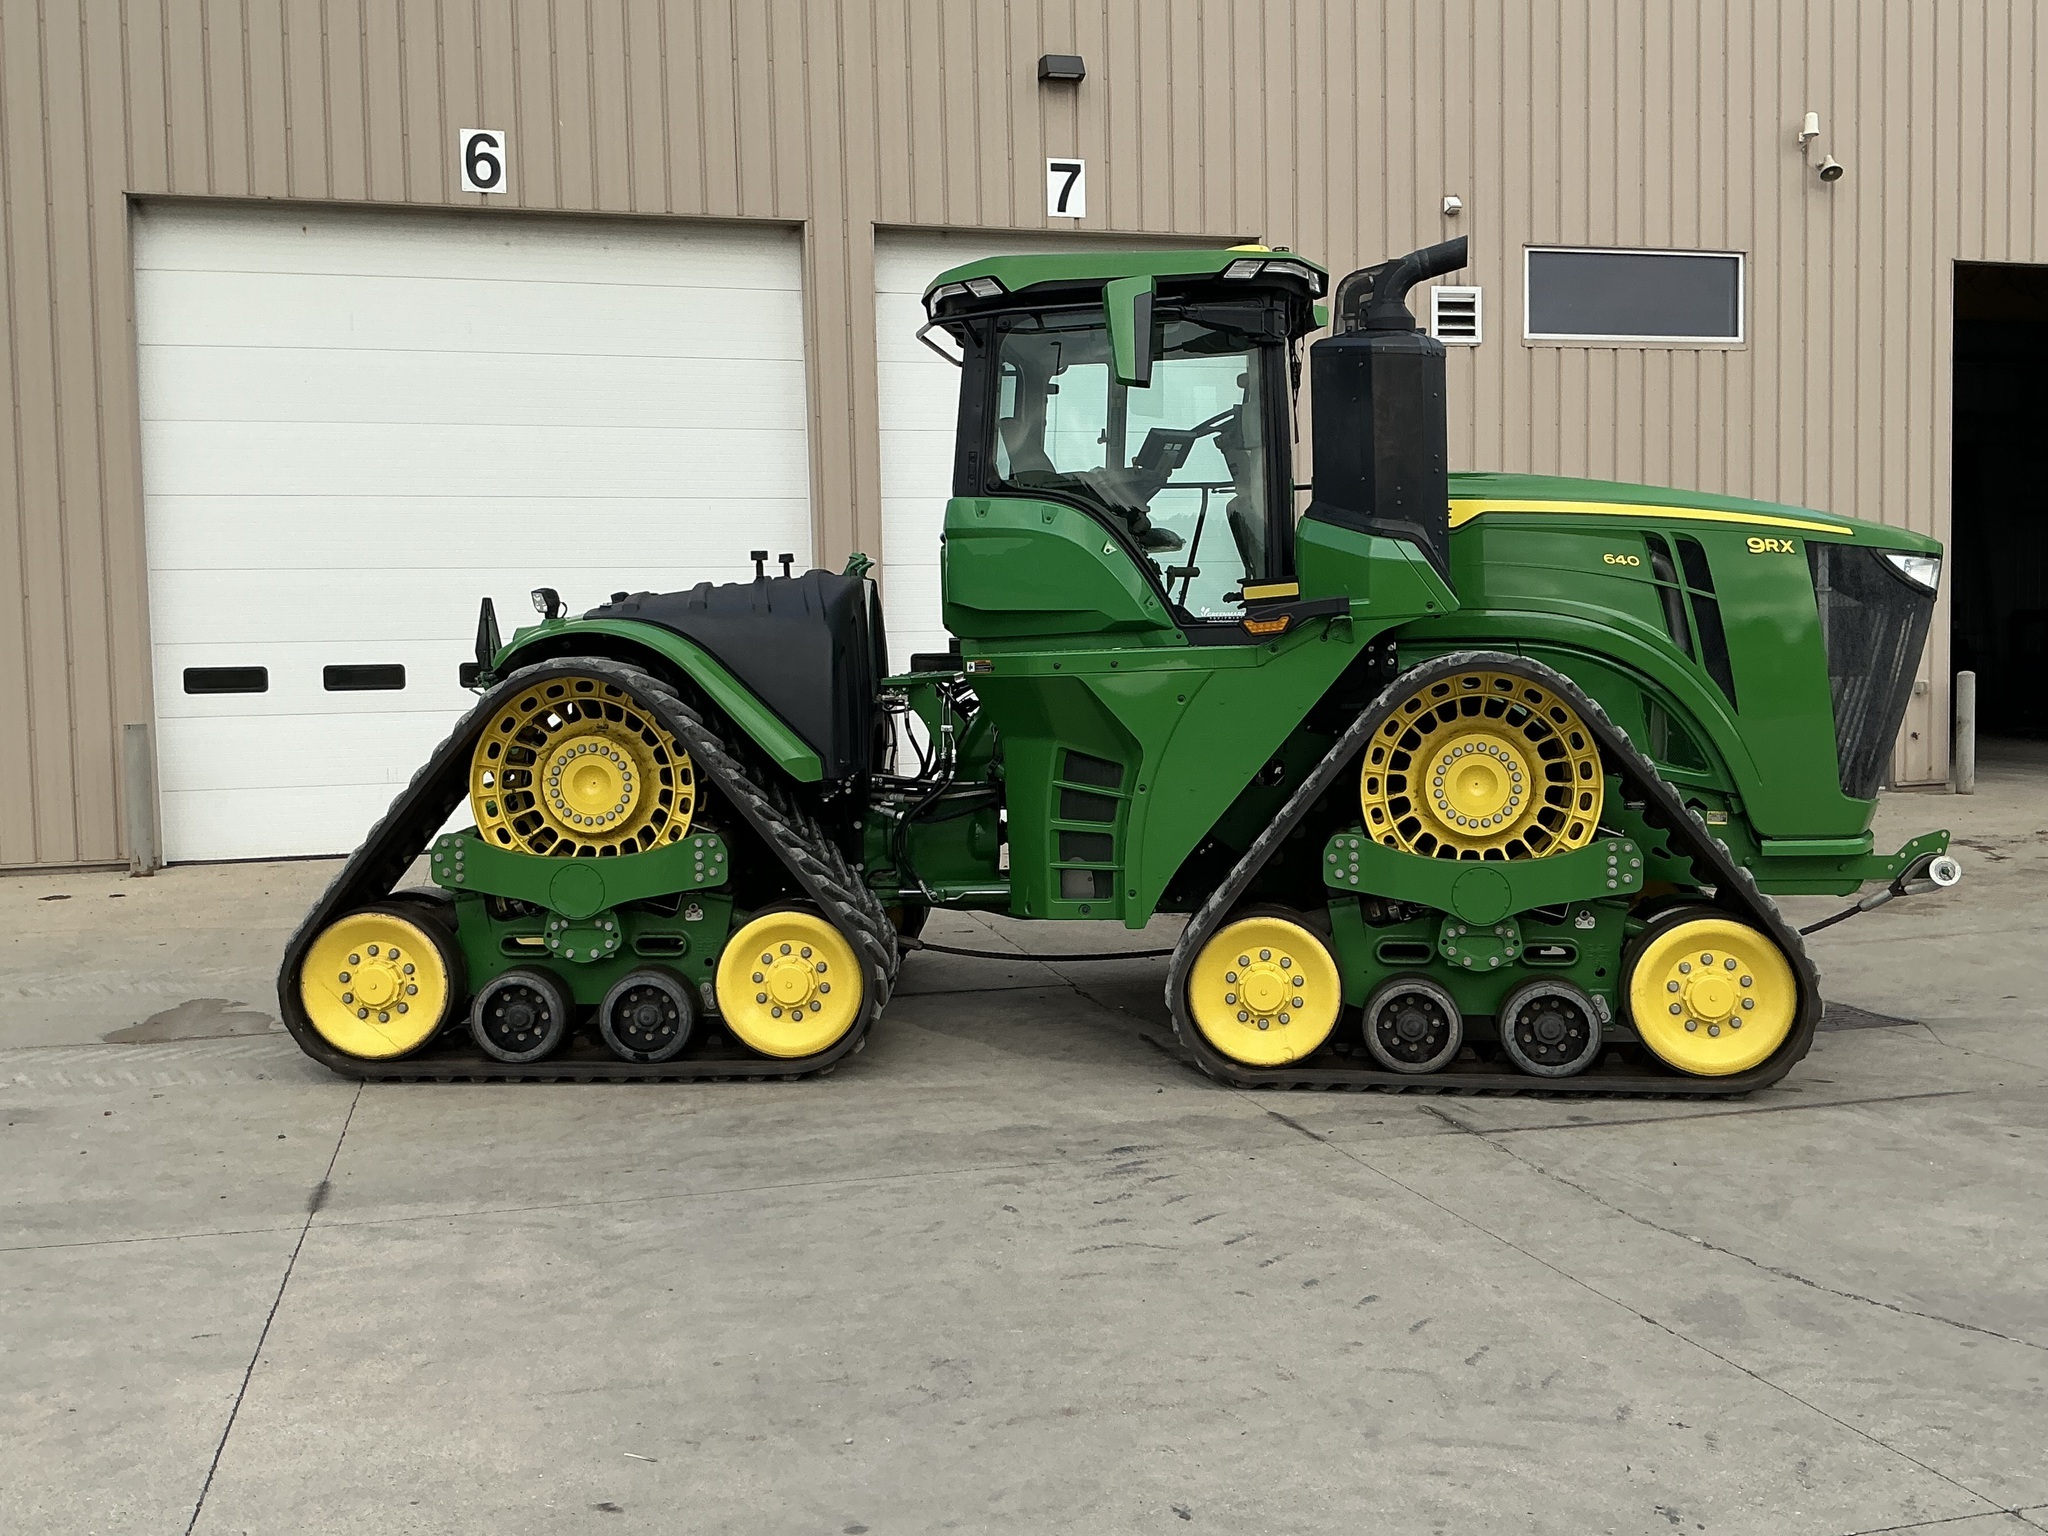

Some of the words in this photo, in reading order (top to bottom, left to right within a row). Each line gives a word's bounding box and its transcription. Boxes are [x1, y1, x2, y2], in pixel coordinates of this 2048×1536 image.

[466, 133, 501, 189] 6
[1051, 163, 1081, 212] 7
[1603, 553, 1640, 567] 640
[1747, 537, 1795, 554] 9RX
